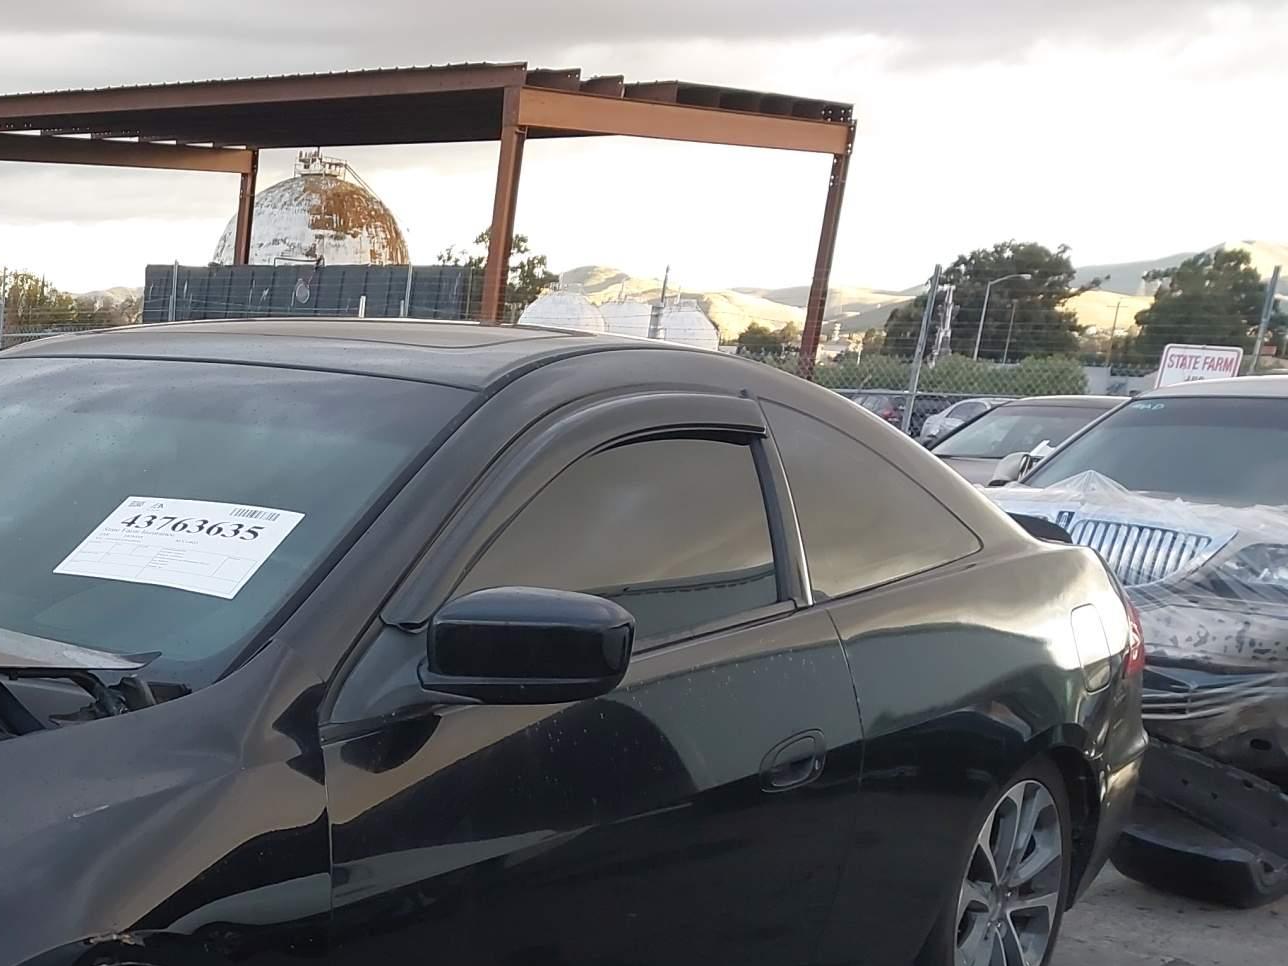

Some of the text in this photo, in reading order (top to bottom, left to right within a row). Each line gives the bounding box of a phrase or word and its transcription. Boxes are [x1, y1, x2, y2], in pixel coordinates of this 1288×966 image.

[1167, 353, 1235, 372] STATE FARM
[121, 513, 265, 541] 43763635
